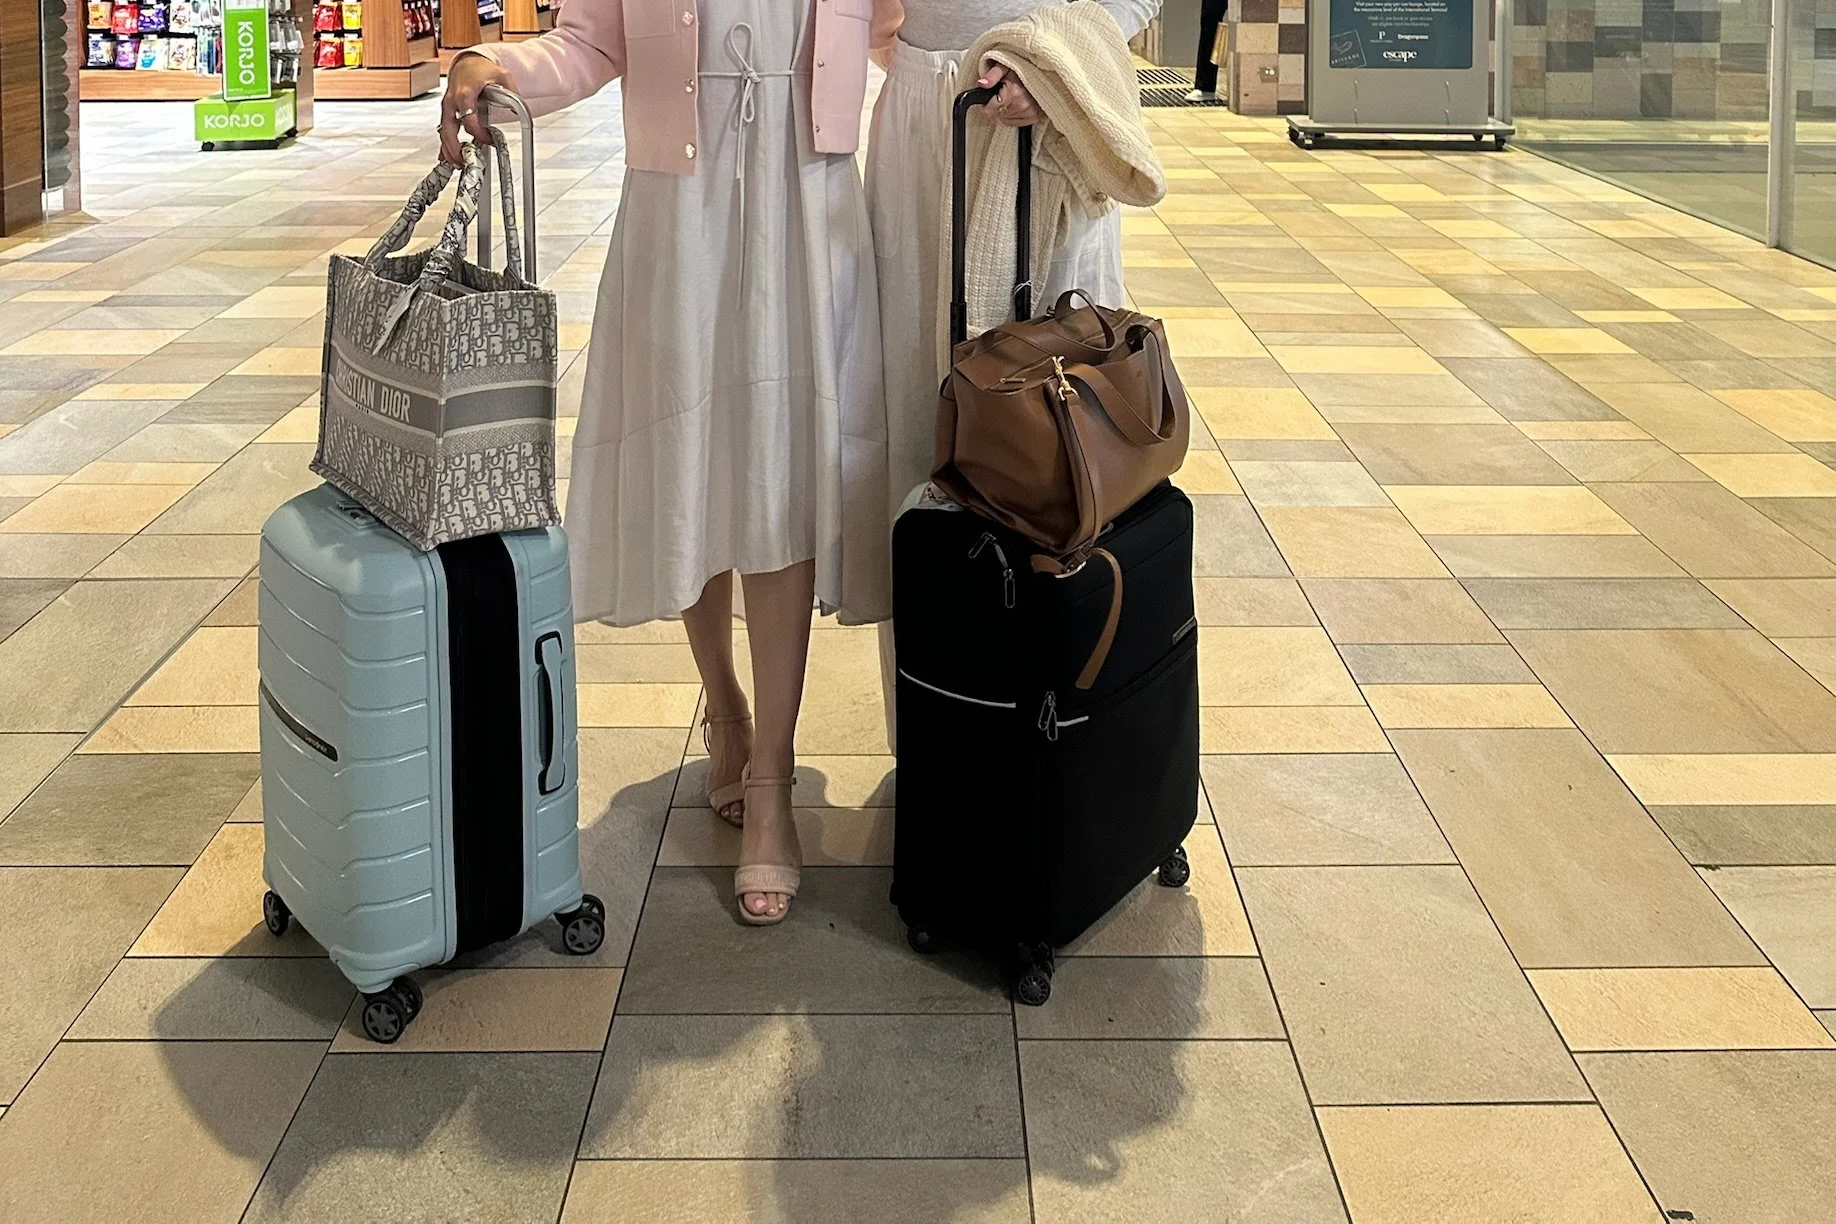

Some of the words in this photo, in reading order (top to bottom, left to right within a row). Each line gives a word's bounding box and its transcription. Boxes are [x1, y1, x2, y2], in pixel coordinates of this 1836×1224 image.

[237, 21, 255, 85] KORJO
[1383, 50, 1417, 63] escape
[204, 114, 265, 128] KORJO
[380, 385, 411, 424] DIOR
